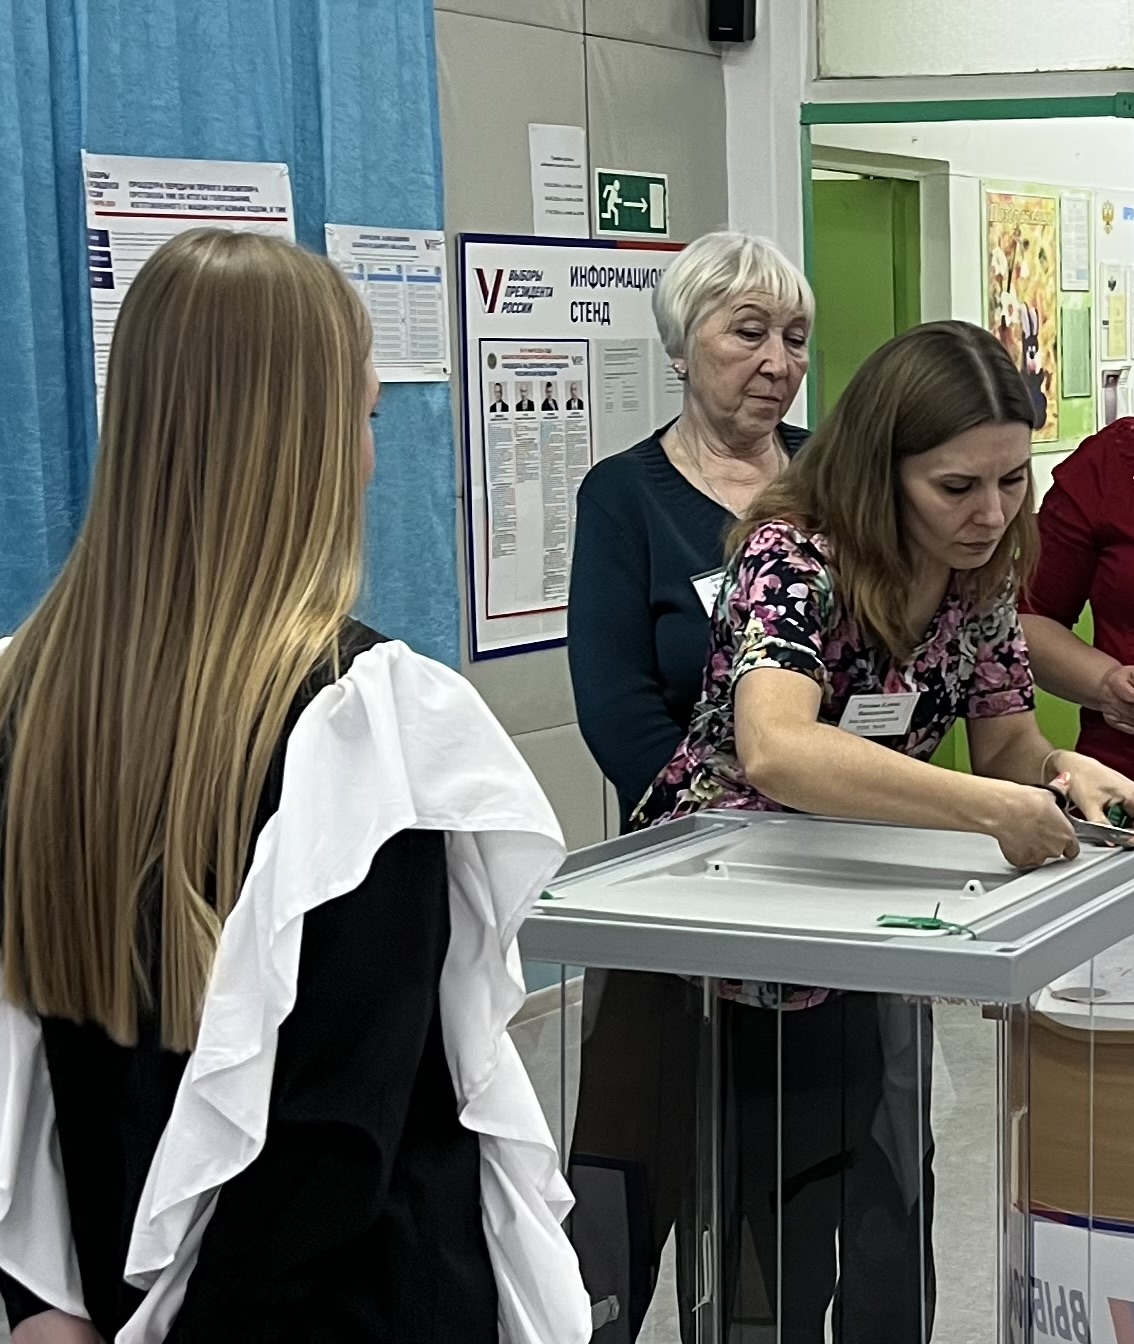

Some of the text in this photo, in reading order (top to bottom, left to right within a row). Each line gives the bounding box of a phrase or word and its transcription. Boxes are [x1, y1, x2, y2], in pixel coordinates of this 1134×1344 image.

[508, 269, 544, 282] ВЫБОРЫ
[570, 265, 666, 292] ИНФОРМАЦИО
[504, 286, 554, 299] ПРЕЗИДЕНТА
[501, 302, 533, 314] РОССИИ
[570, 301, 611, 325] СТЕНД
